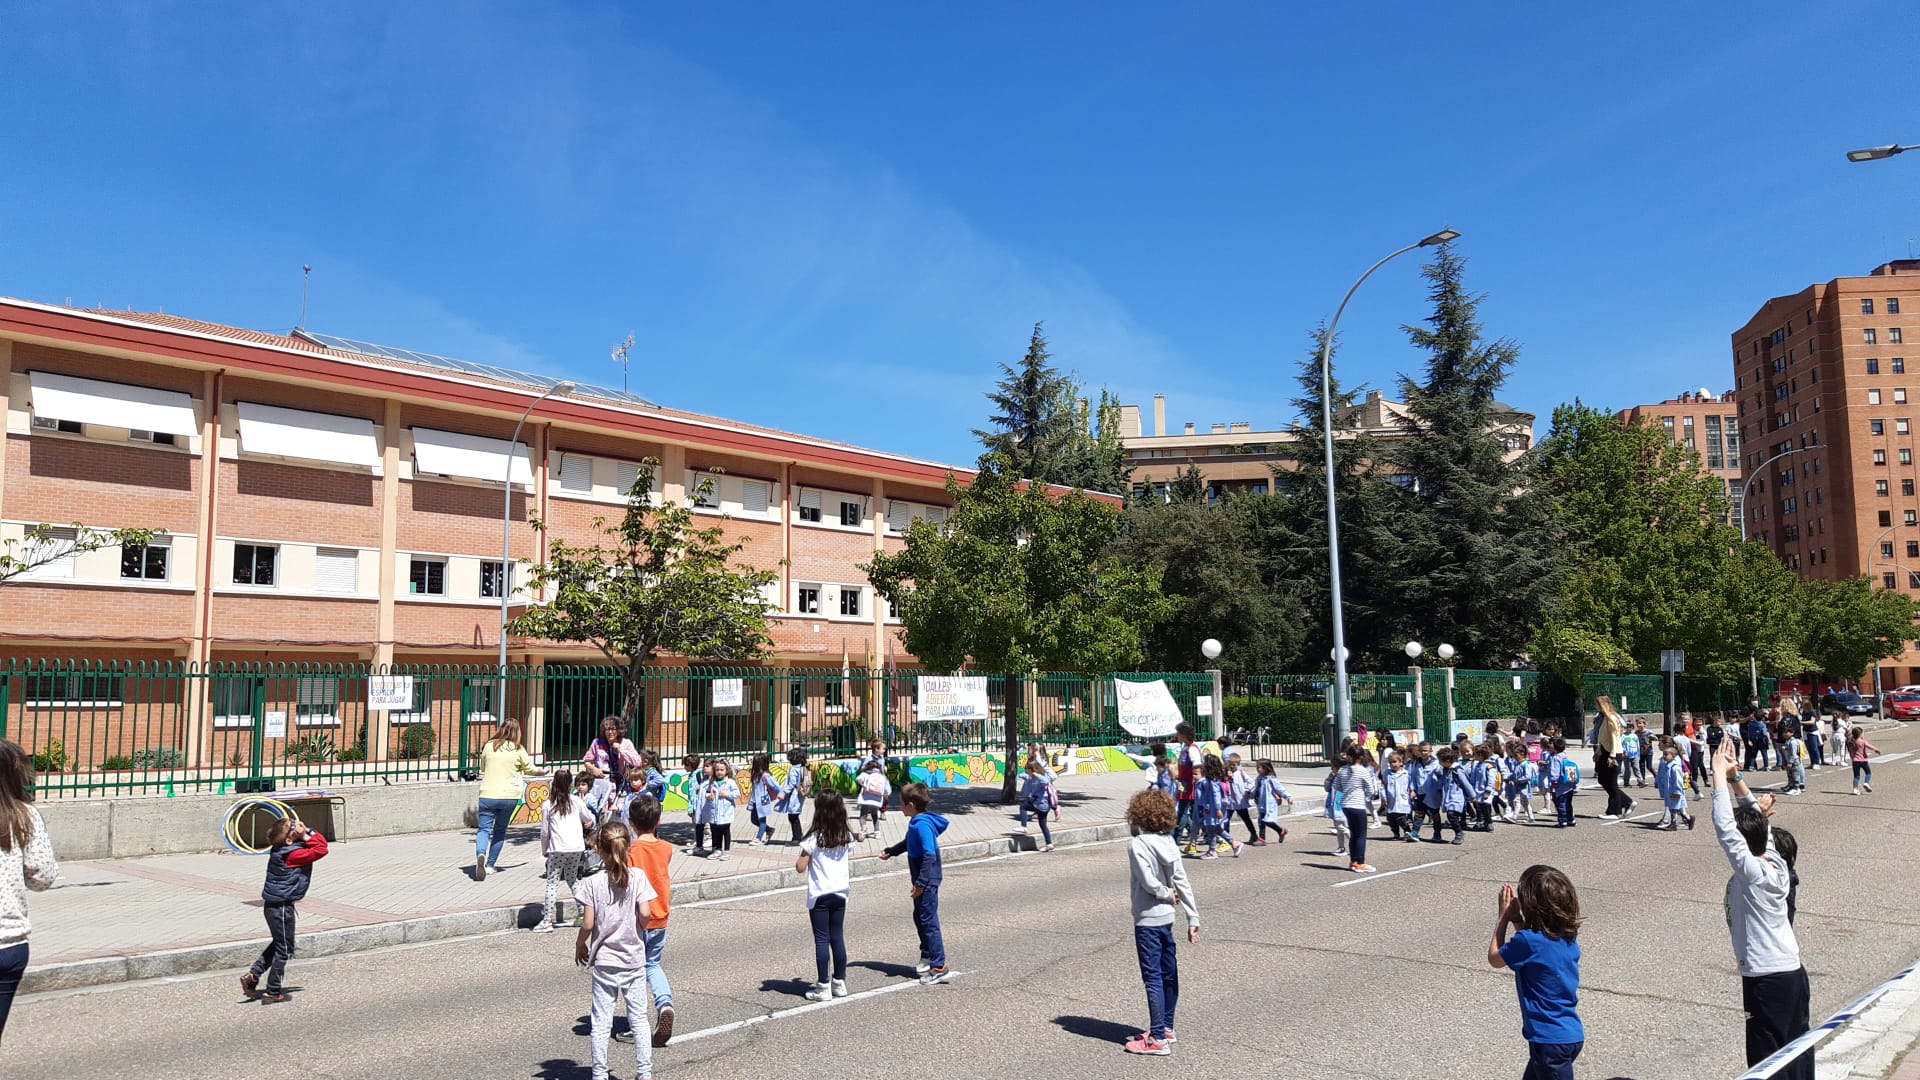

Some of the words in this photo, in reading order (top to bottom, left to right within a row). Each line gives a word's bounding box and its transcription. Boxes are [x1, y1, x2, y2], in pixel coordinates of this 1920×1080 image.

[371, 696, 386, 704] PARA
[387, 696, 406, 704] JUGAR
[925, 693, 957, 705] ABIERTAS
[925, 705, 941, 716] PARA
[942, 705, 950, 716] LA
[950, 704, 975, 716] INFANCIA
